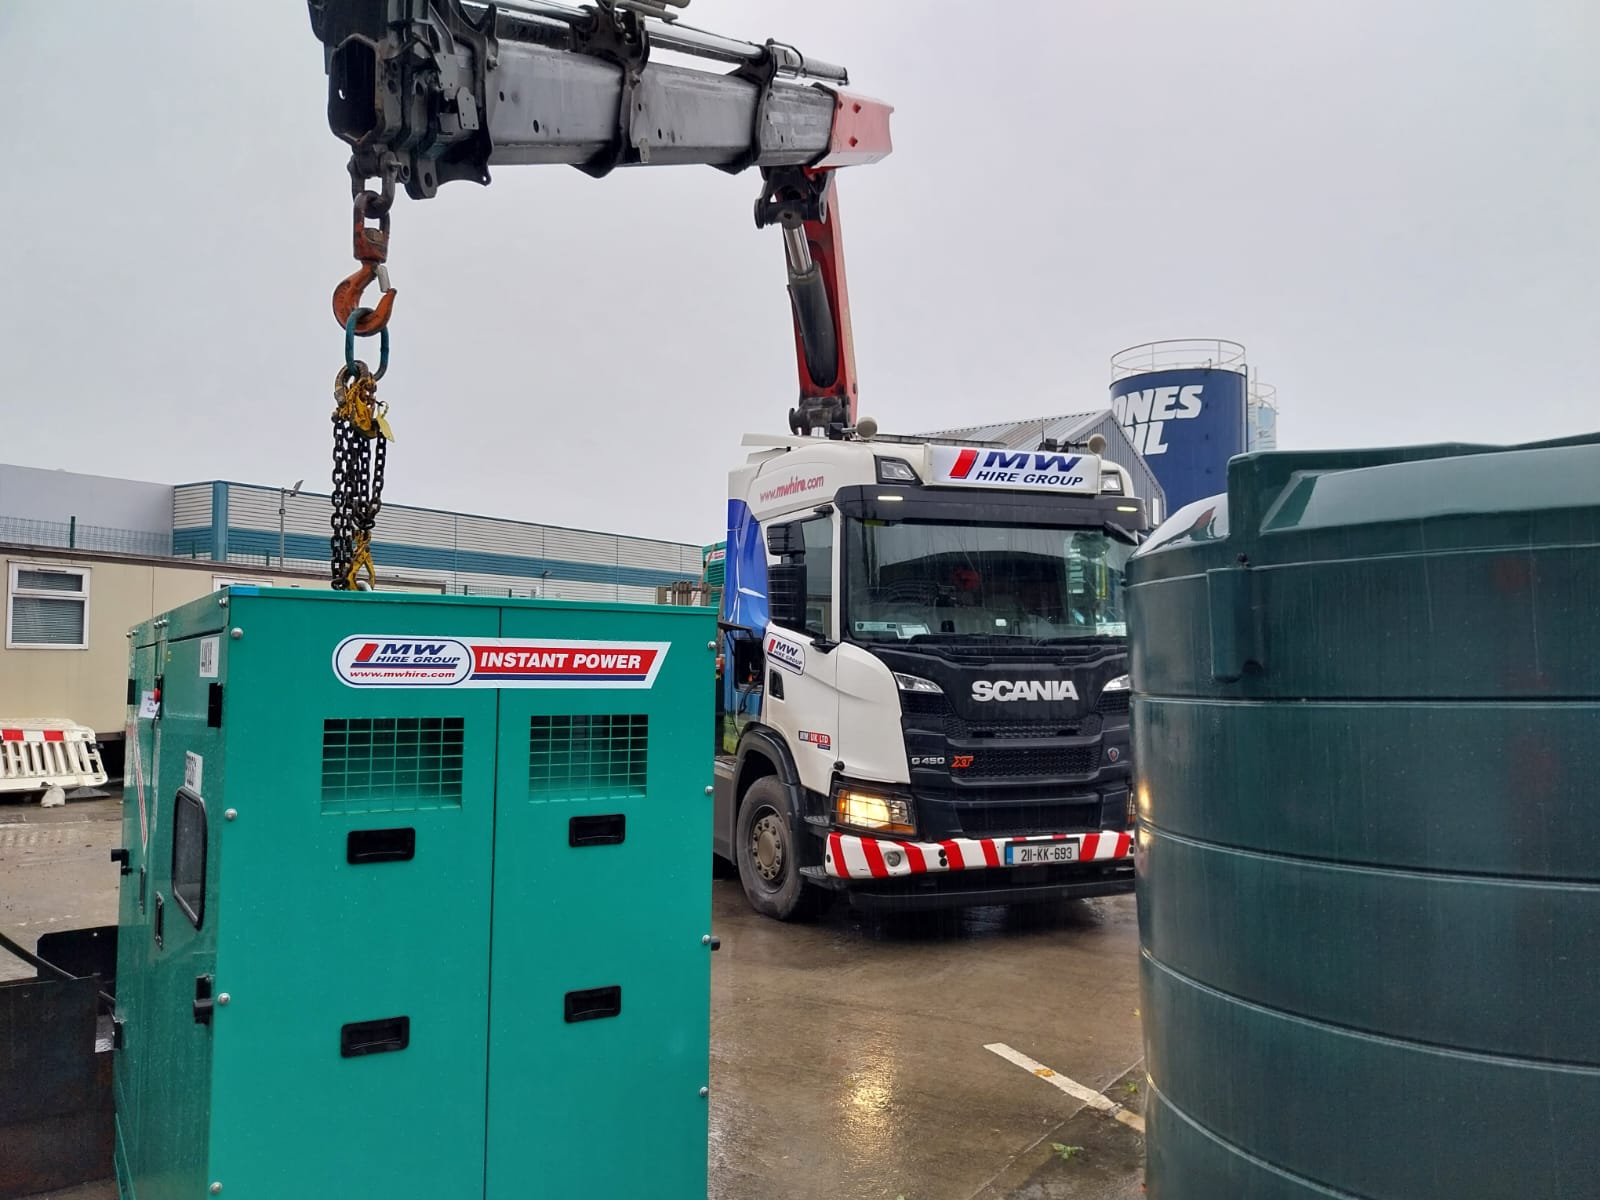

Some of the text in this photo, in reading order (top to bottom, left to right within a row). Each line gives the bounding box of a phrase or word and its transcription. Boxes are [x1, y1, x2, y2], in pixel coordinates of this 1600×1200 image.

[983, 451, 1082, 472] MW
[976, 471, 1083, 486] HIRE GROUP
[760, 475, 824, 503] www.mwhire.com
[380, 644, 447, 655] MW
[775, 641, 798, 656] MW
[480, 652, 642, 669] INSTANT POWER
[785, 655, 802, 665] GROUP
[971, 680, 1080, 701] SCANIA
[921, 757, 945, 765] 450
[952, 755, 974, 768] XT
[1021, 846, 1072, 862] 211-KK-693
